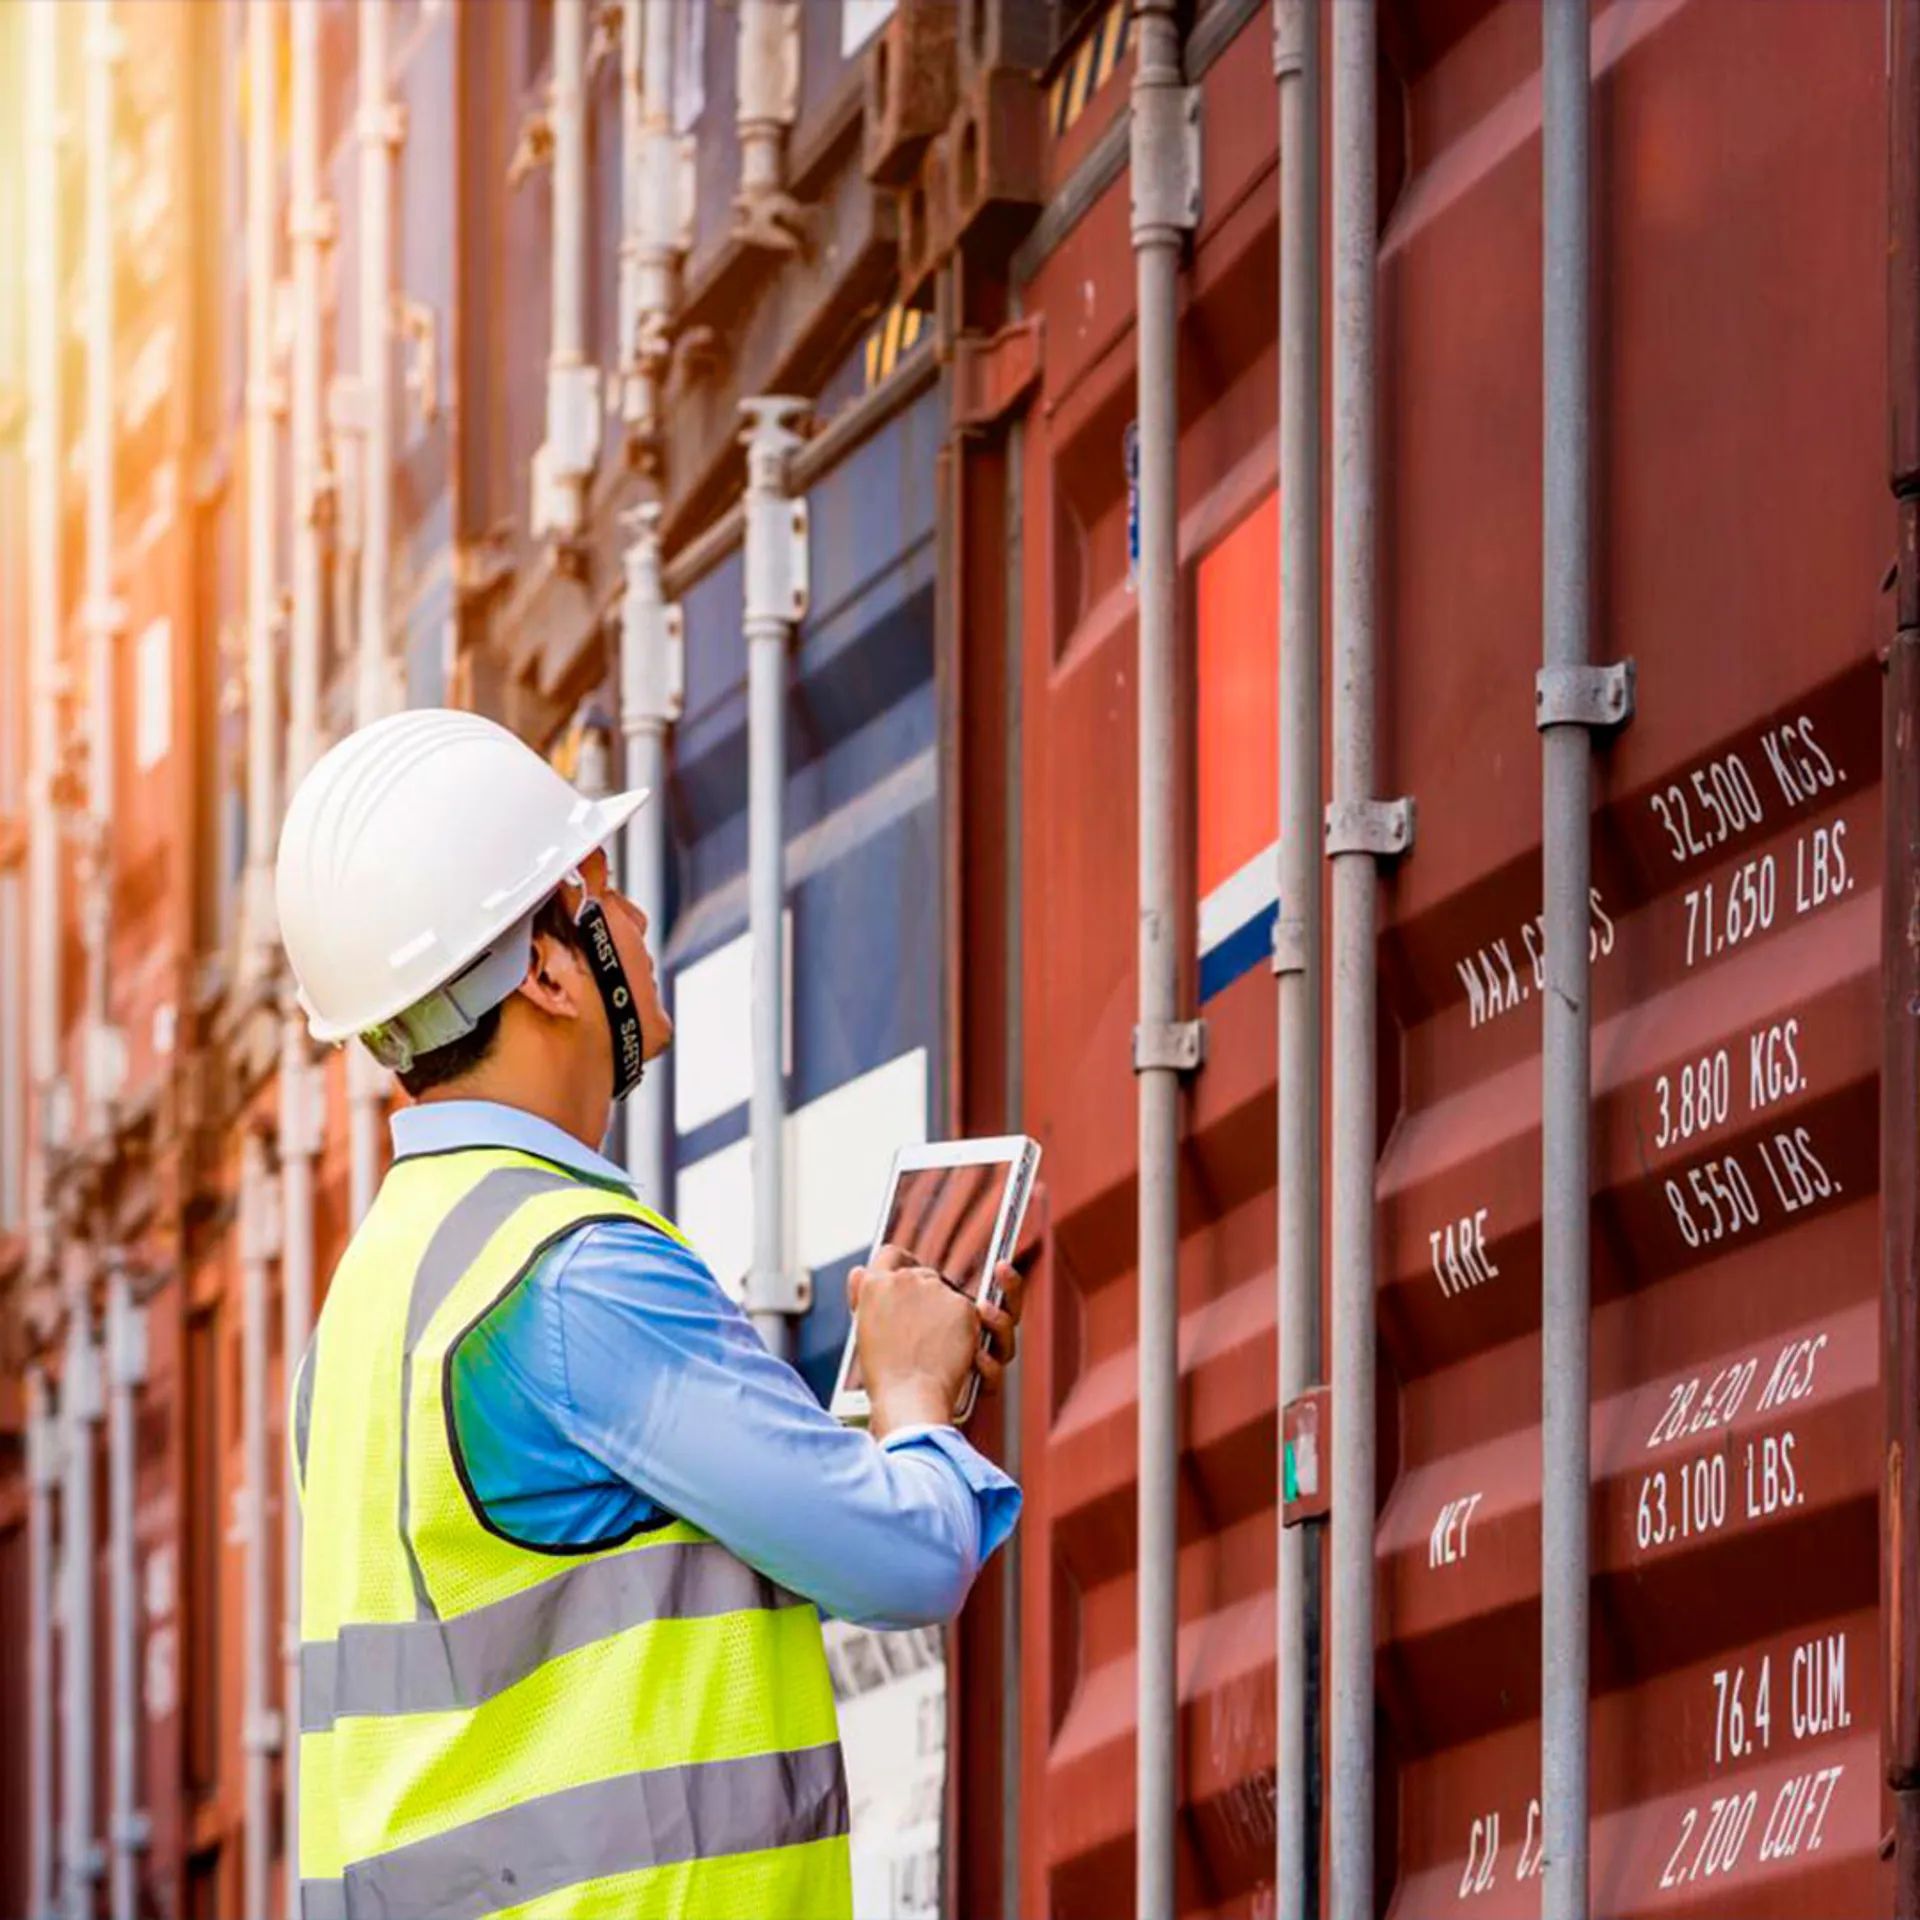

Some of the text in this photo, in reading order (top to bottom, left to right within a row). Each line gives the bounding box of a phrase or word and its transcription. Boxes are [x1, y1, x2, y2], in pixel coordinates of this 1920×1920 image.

[1650, 716, 1847, 862] 32,500 KGS.
[589, 916, 618, 973] FIRST
[1685, 819, 1854, 966] 71,650 LBS.
[1655, 1018, 1808, 1149] 3,880 KGS.
[1664, 1127, 1843, 1248] 8,550 LBS.
[1429, 1207, 1499, 1299] TARE
[1646, 1333, 1828, 1448] 28,620 KGS.
[1429, 1491, 1482, 1570] NET
[1637, 1431, 1804, 1549] 63,100 LBS.
[1712, 1632, 1851, 1764] 76.4 CU.M.
[1459, 1812, 1500, 1898] CU.
[1658, 1790, 1758, 1889] 2,700
